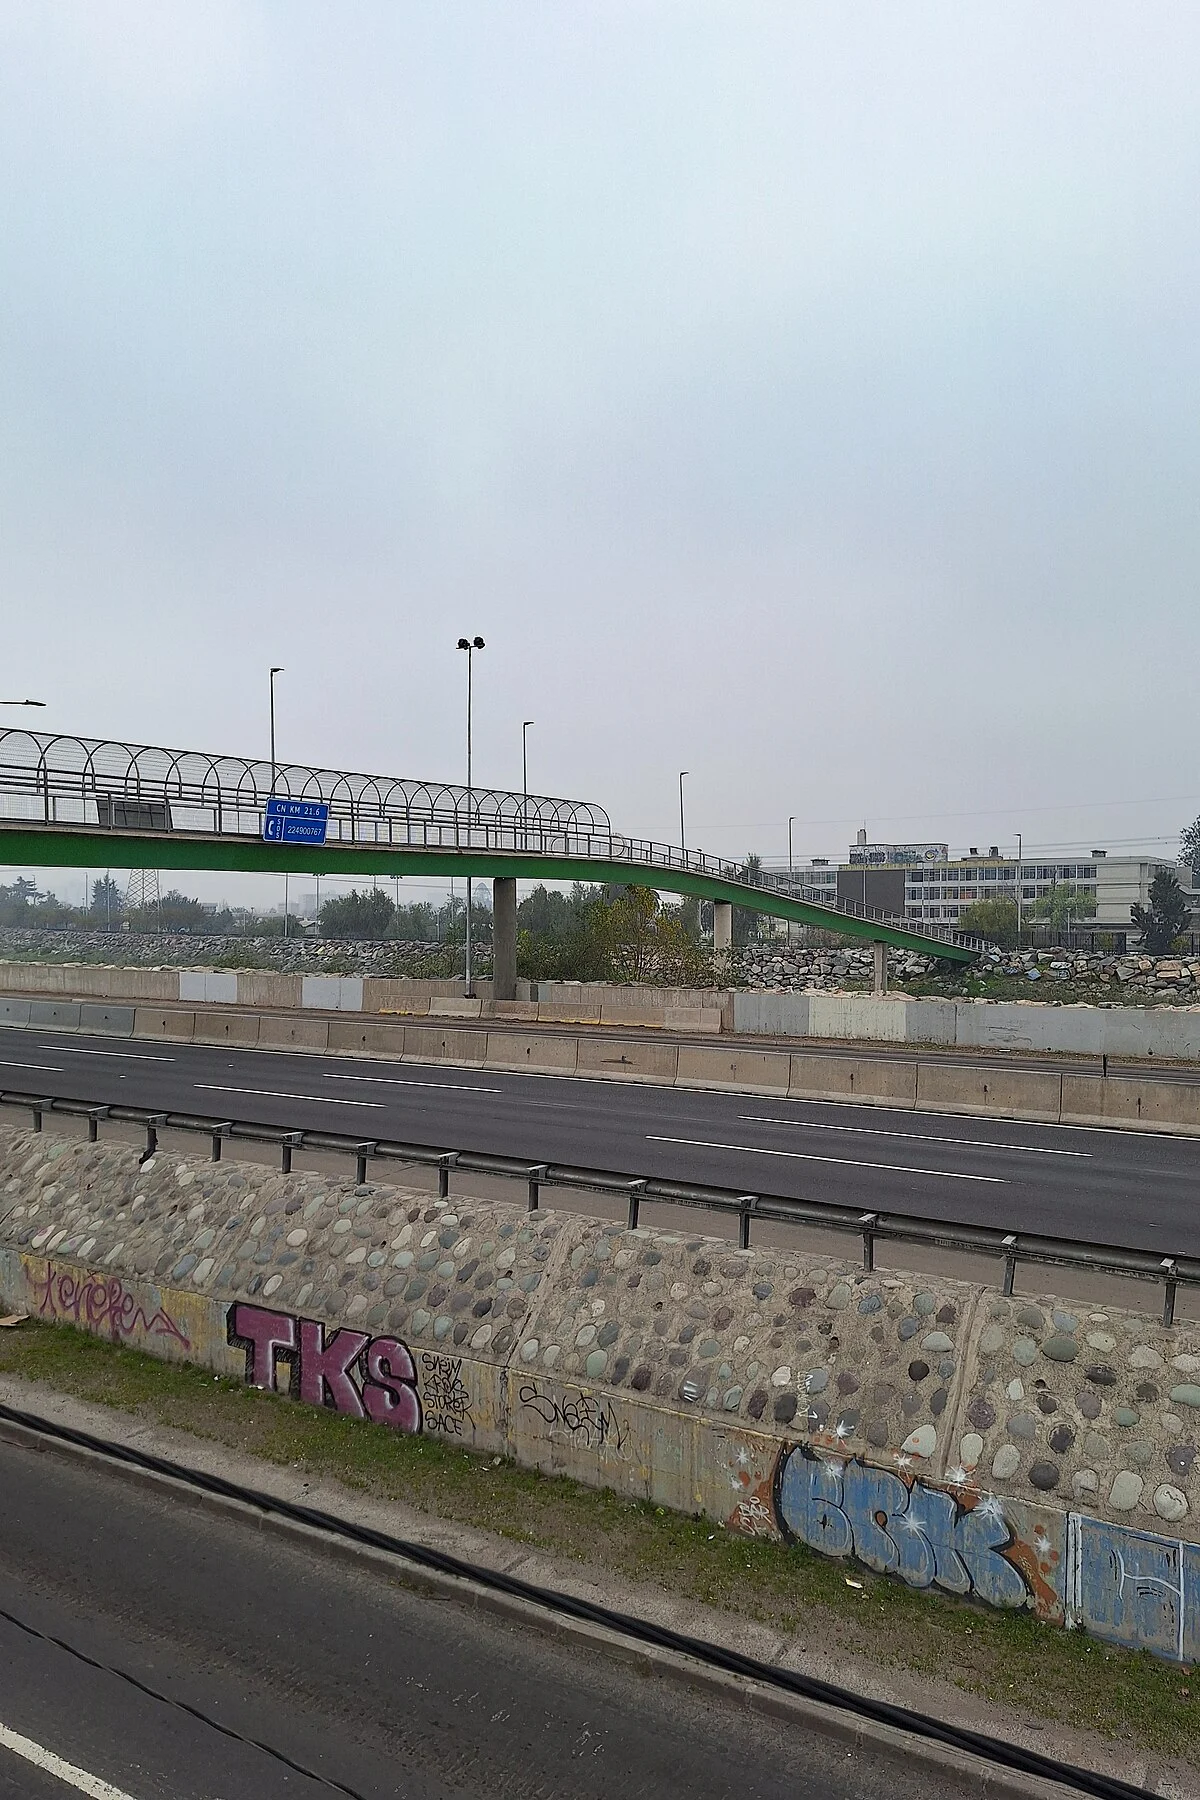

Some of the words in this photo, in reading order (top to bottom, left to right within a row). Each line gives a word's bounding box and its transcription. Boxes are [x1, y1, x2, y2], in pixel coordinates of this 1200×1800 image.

[276, 804, 287, 813] CN
[289, 805, 301, 815] KM
[304, 807, 320, 816] 21.6
[287, 825, 322, 836] 224900767
[226, 1301, 423, 1434] TKS
